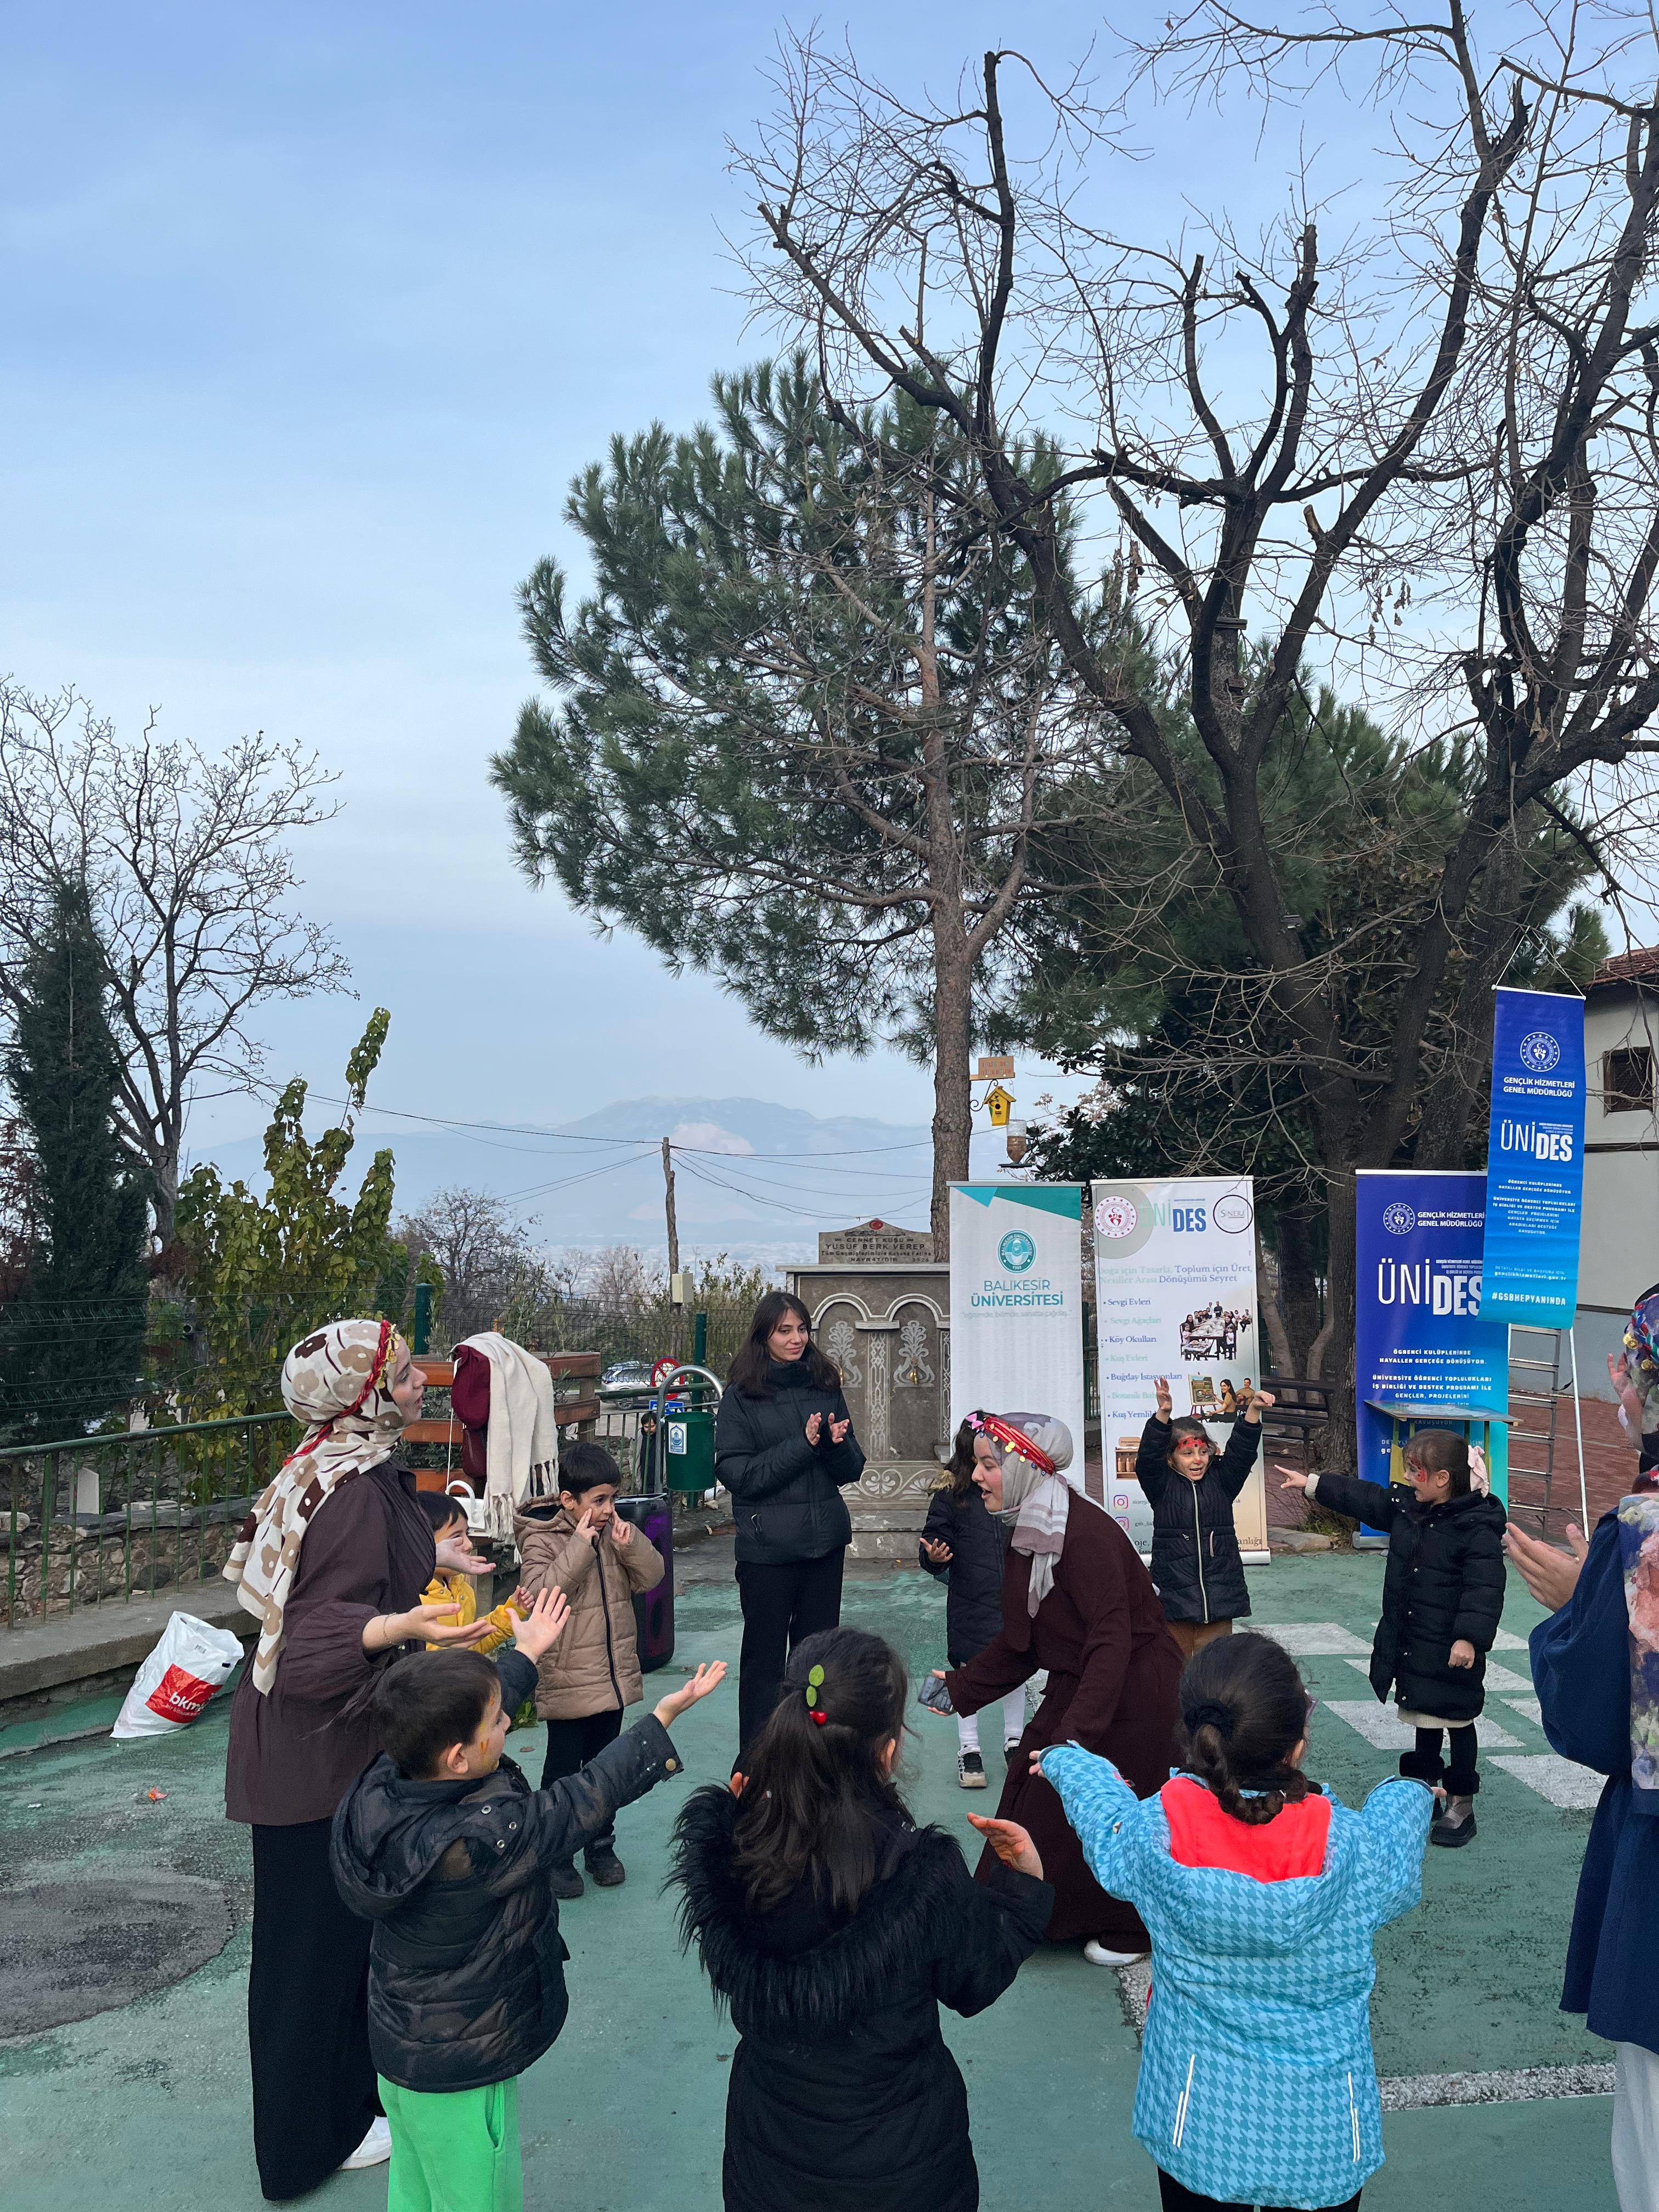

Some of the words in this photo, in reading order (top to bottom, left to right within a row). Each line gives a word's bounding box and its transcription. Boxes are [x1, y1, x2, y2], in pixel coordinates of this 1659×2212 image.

[1504, 1076, 1533, 1086] GENÇLİK
[1534, 1078, 1575, 1089] HİZMETLERİ
[1503, 1086, 1526, 1094] GENEL
[1527, 1087, 1573, 1097] MÜDÜRLÜĞÜ
[1417, 1211, 1446, 1220] GENÇLİK
[1440, 1219, 1483, 1227] MÜDÜRLÜĞÜ
[1175, 1265, 1210, 1274] Toplum
[1212, 1264, 1228, 1274] için
[1231, 1263, 1252, 1273] Üret,
[984, 1277, 1051, 1291] BALIKESİR
[1159, 1274, 1207, 1284] Dönüşümü
[1209, 1274, 1238, 1284] Seyret
[971, 1291, 1064, 1307] ÜNİVERSİTESİ
[1108, 1299, 1127, 1307] Sevgi
[1492, 1291, 1566, 1306] #GSBHEPYANINDA
[1109, 1335, 1124, 1344] Köy
[1111, 1373, 1139, 1381] Buğday
[1112, 1410, 1127, 1419] Kuş
